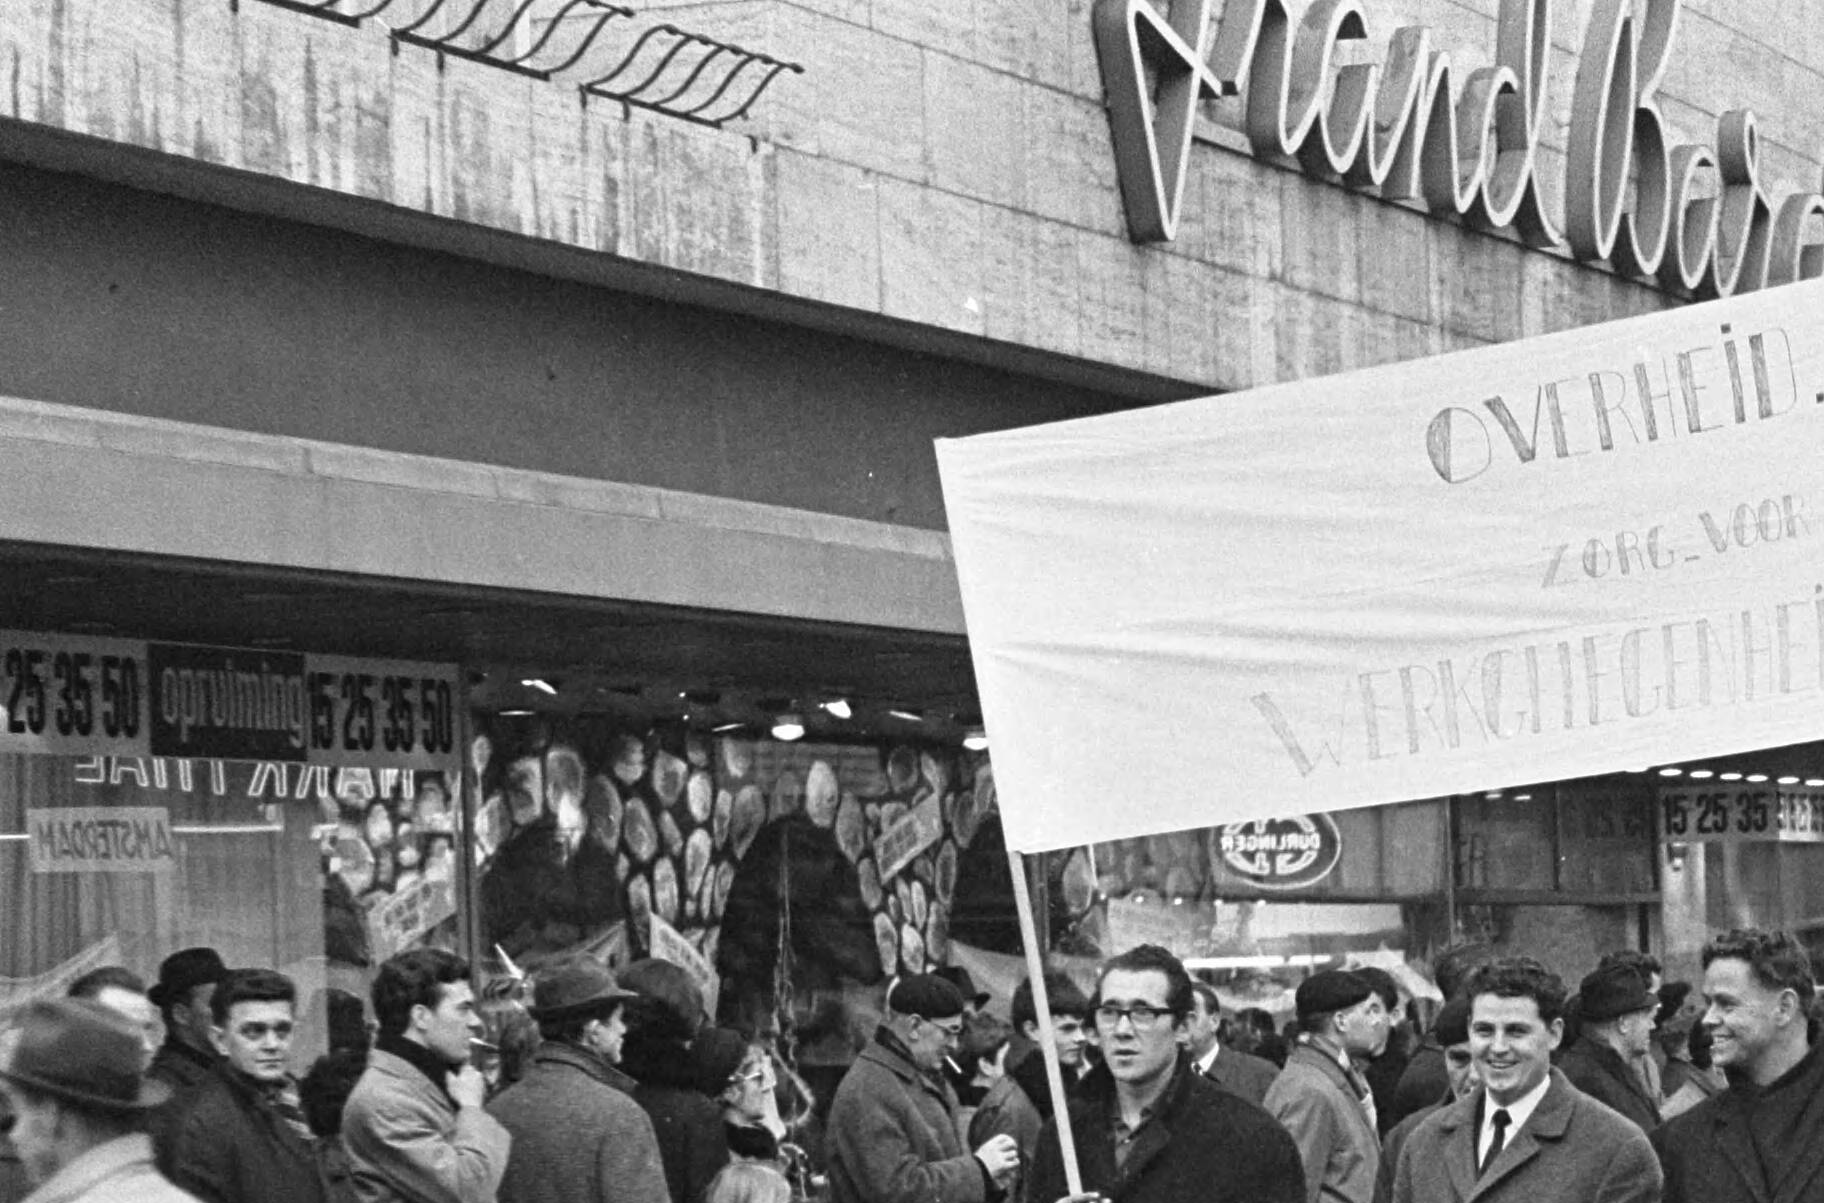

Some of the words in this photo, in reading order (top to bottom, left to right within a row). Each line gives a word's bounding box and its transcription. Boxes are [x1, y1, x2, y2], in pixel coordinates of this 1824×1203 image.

[6, 648, 46, 735] 25
[54, 652, 93, 737] 35
[102, 655, 140, 739] 50
[160, 656, 304, 748] opruiming
[342, 672, 374, 752] 25
[383, 675, 416, 754] 35
[421, 679, 453, 754] 50
[1664, 794, 1688, 835] 15
[1696, 793, 1728, 834] 25
[1737, 792, 1769, 832] 35
